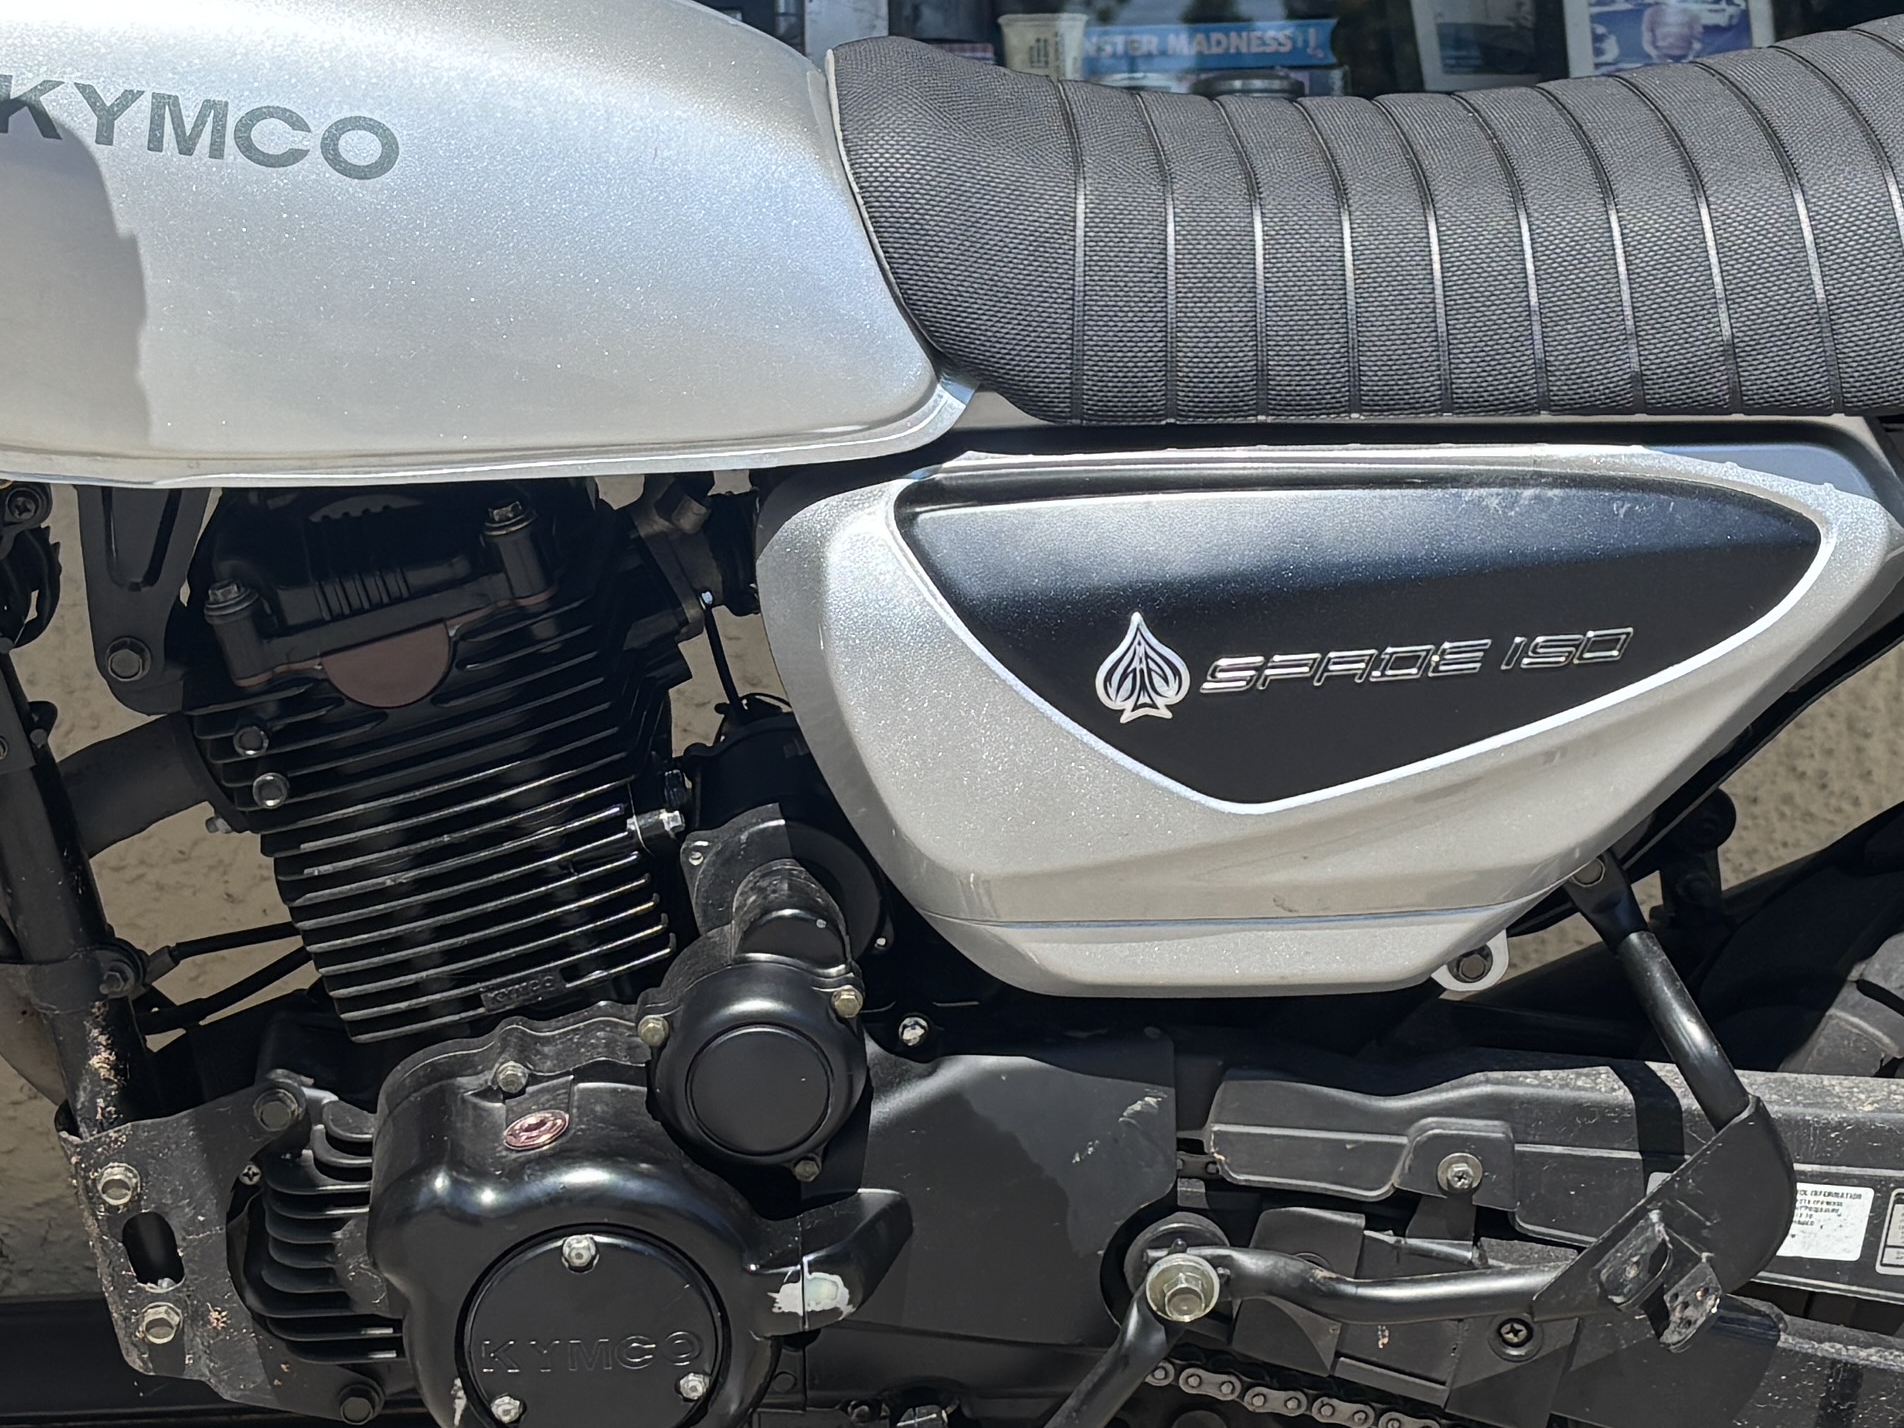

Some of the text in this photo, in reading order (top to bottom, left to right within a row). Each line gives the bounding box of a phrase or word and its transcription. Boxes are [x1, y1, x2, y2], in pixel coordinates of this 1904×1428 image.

[1167, 28, 1293, 57] MADNESS
[1199, 626, 1635, 694] SPADE 150
[489, 975, 555, 1009] KYMCO
[481, 1328, 705, 1374] KYMCO
